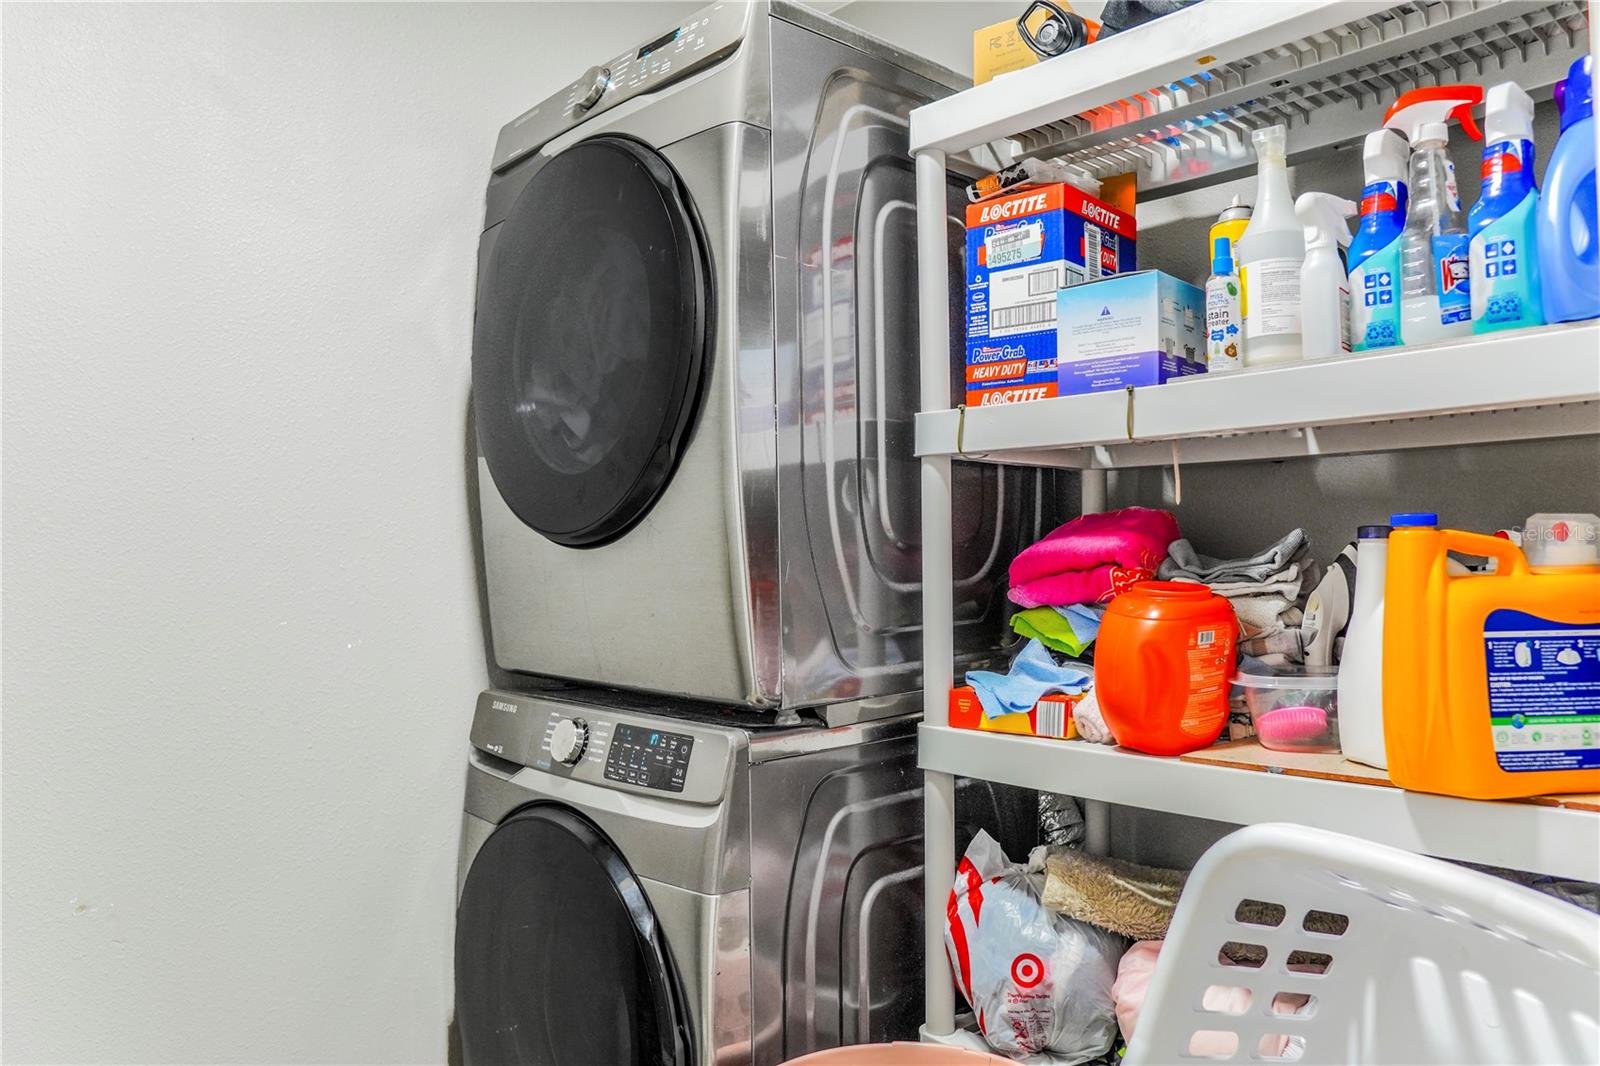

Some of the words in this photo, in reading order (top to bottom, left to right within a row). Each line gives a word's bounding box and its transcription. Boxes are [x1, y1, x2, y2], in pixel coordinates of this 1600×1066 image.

[980, 193, 1047, 223] LOCTITE
[1081, 199, 1120, 230] LOCTITE
[1208, 309, 1229, 320] stain
[972, 347, 1001, 363] Power
[1002, 345, 1025, 360] Grab
[973, 364, 1002, 379] HEAVY
[1001, 362, 1025, 376] DUTY
[981, 387, 1047, 407] LOCTITE
[1487, 641, 1493, 650] 1
[1534, 640, 1541, 649] 2
[1577, 639, 1584, 648] 3
[492, 700, 518, 713] SAMSUNG
